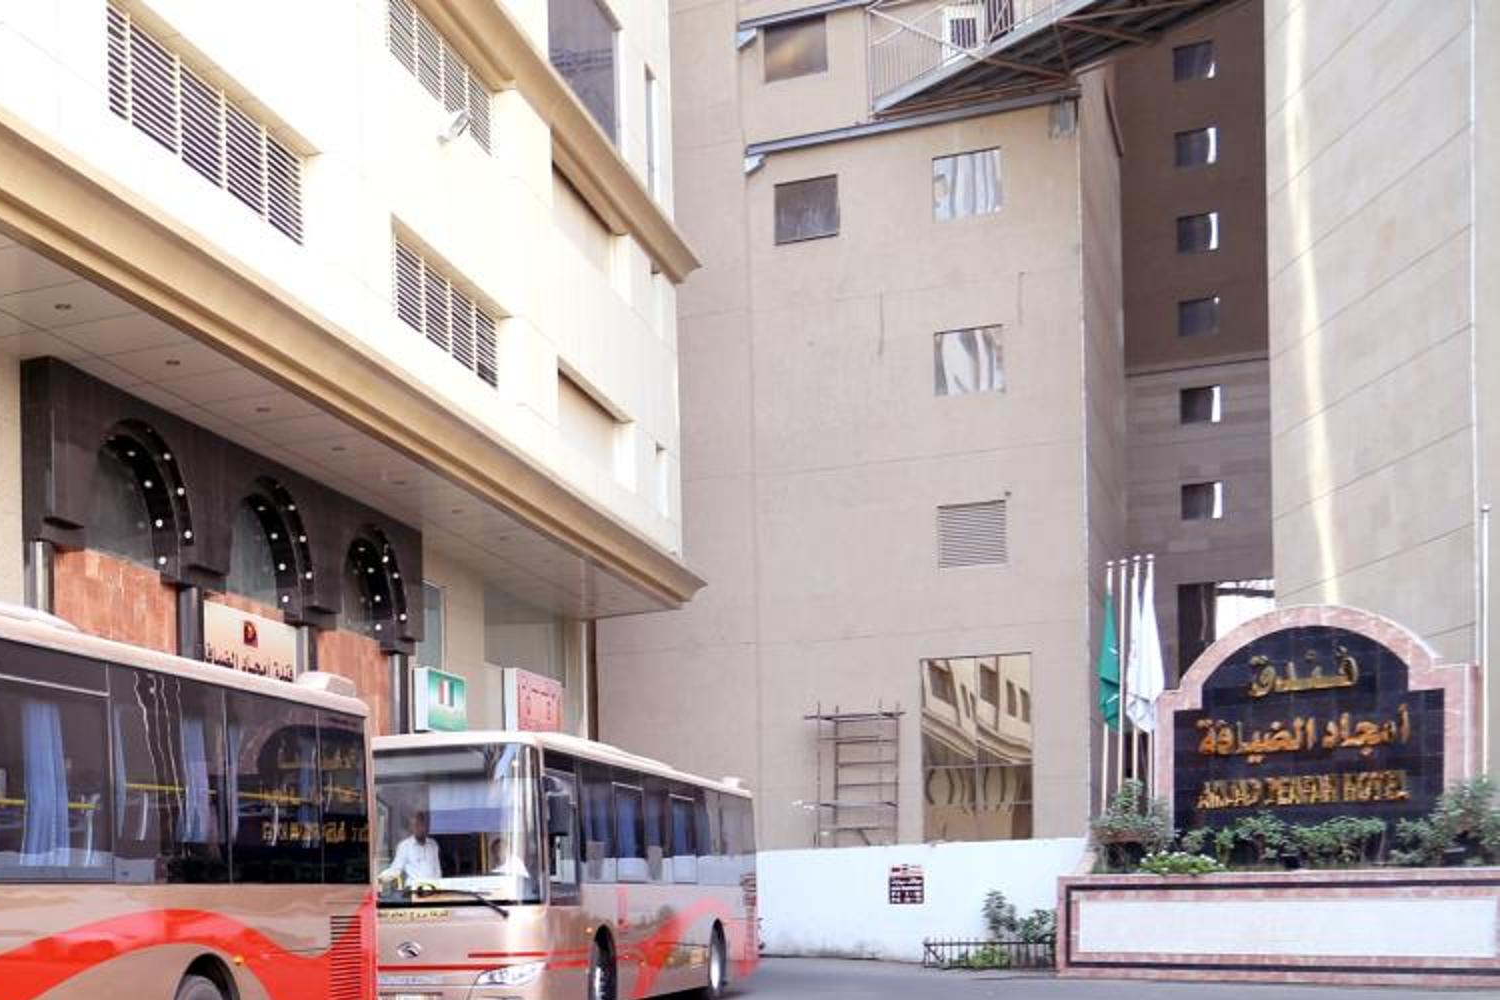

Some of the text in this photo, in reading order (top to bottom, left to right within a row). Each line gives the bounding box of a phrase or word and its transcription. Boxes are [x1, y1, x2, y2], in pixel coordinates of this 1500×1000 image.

[1250, 645, 1358, 698] فندق
[1196, 718, 1317, 764] الضيافة
[1342, 769, 1412, 801] HOTEL
